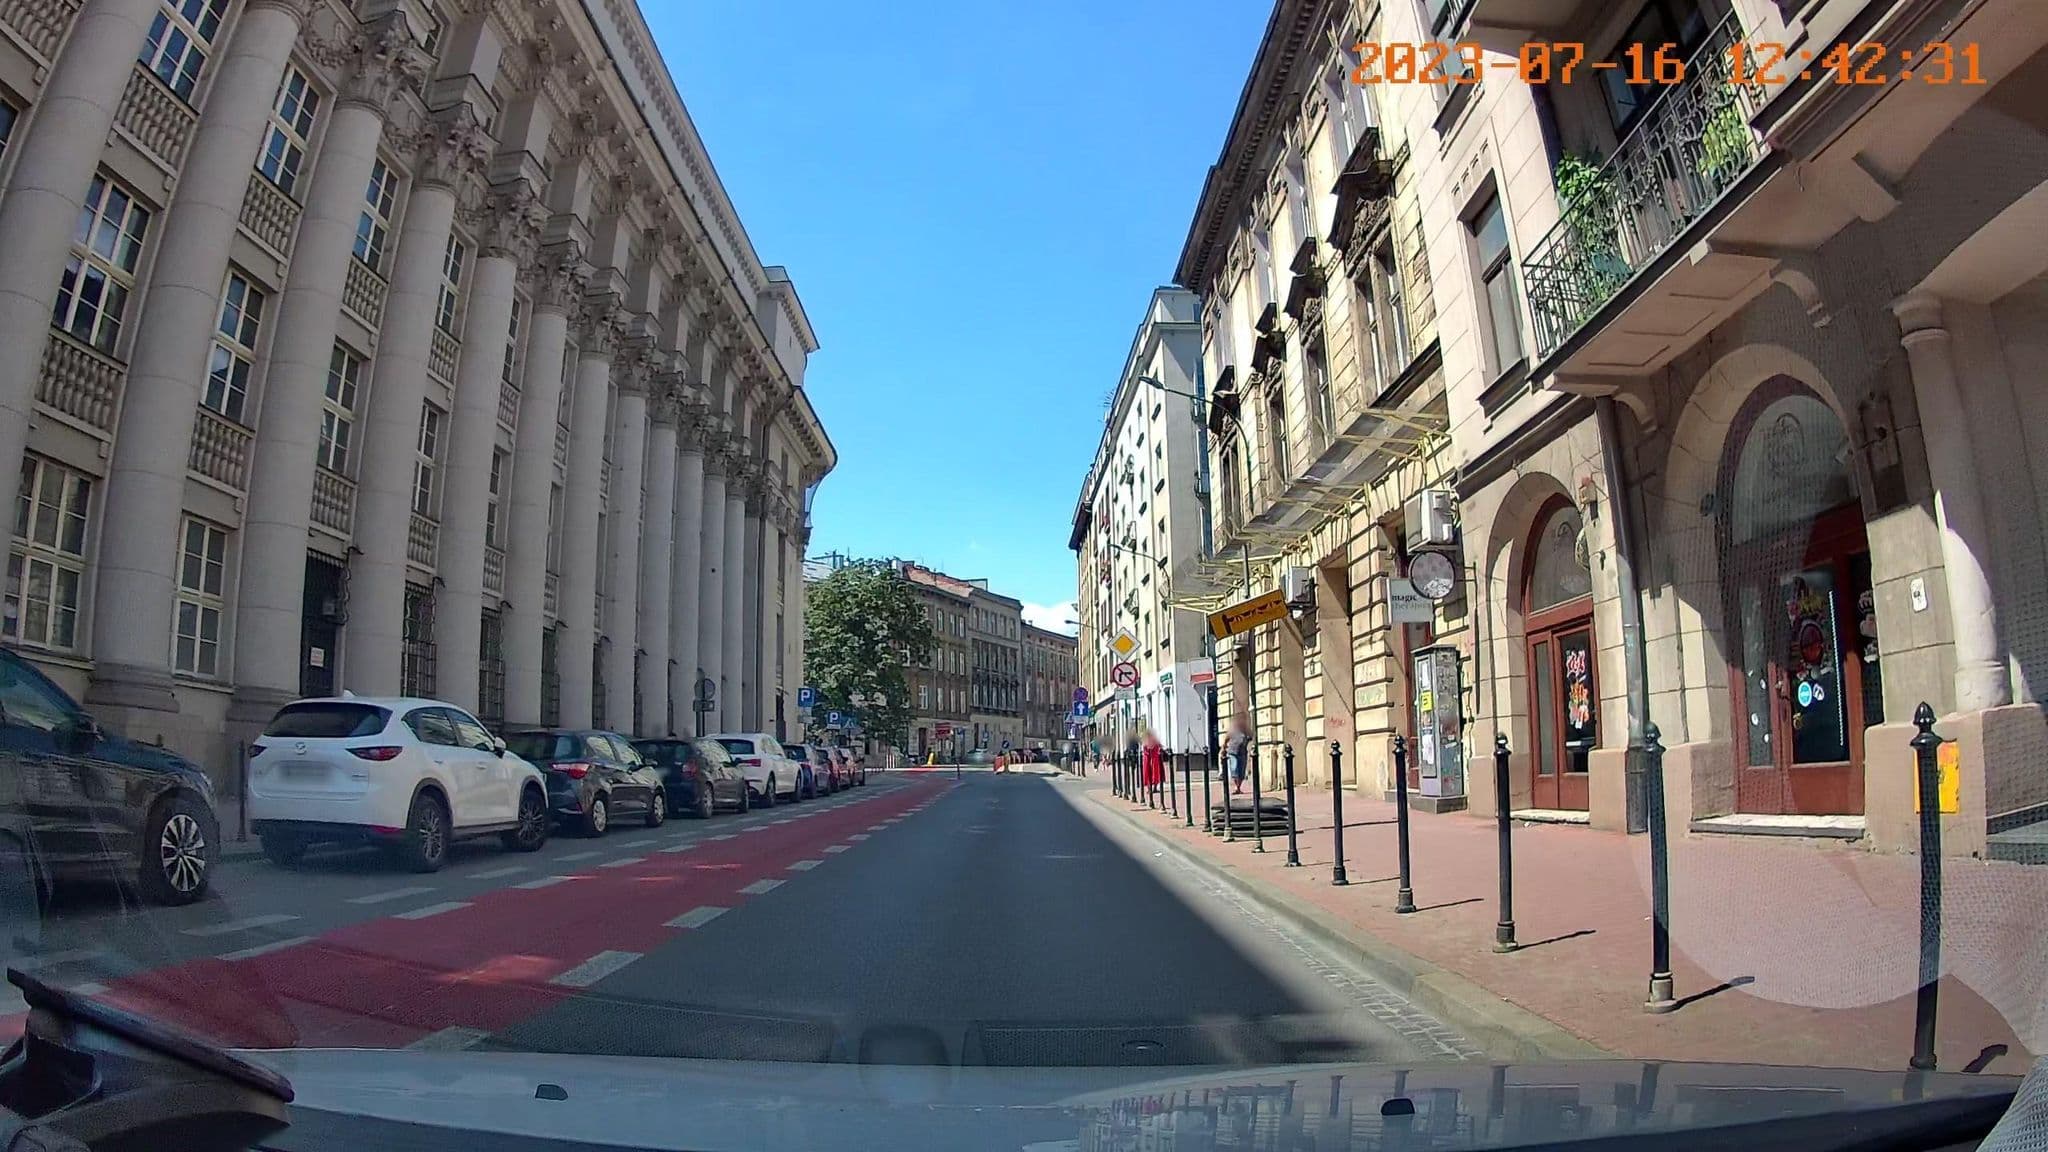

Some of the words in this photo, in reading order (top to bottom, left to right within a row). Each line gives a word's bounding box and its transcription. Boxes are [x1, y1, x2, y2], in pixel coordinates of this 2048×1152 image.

[1391, 594, 1417, 603] magic
[800, 690, 811, 702] P
[829, 712, 839, 723] P
